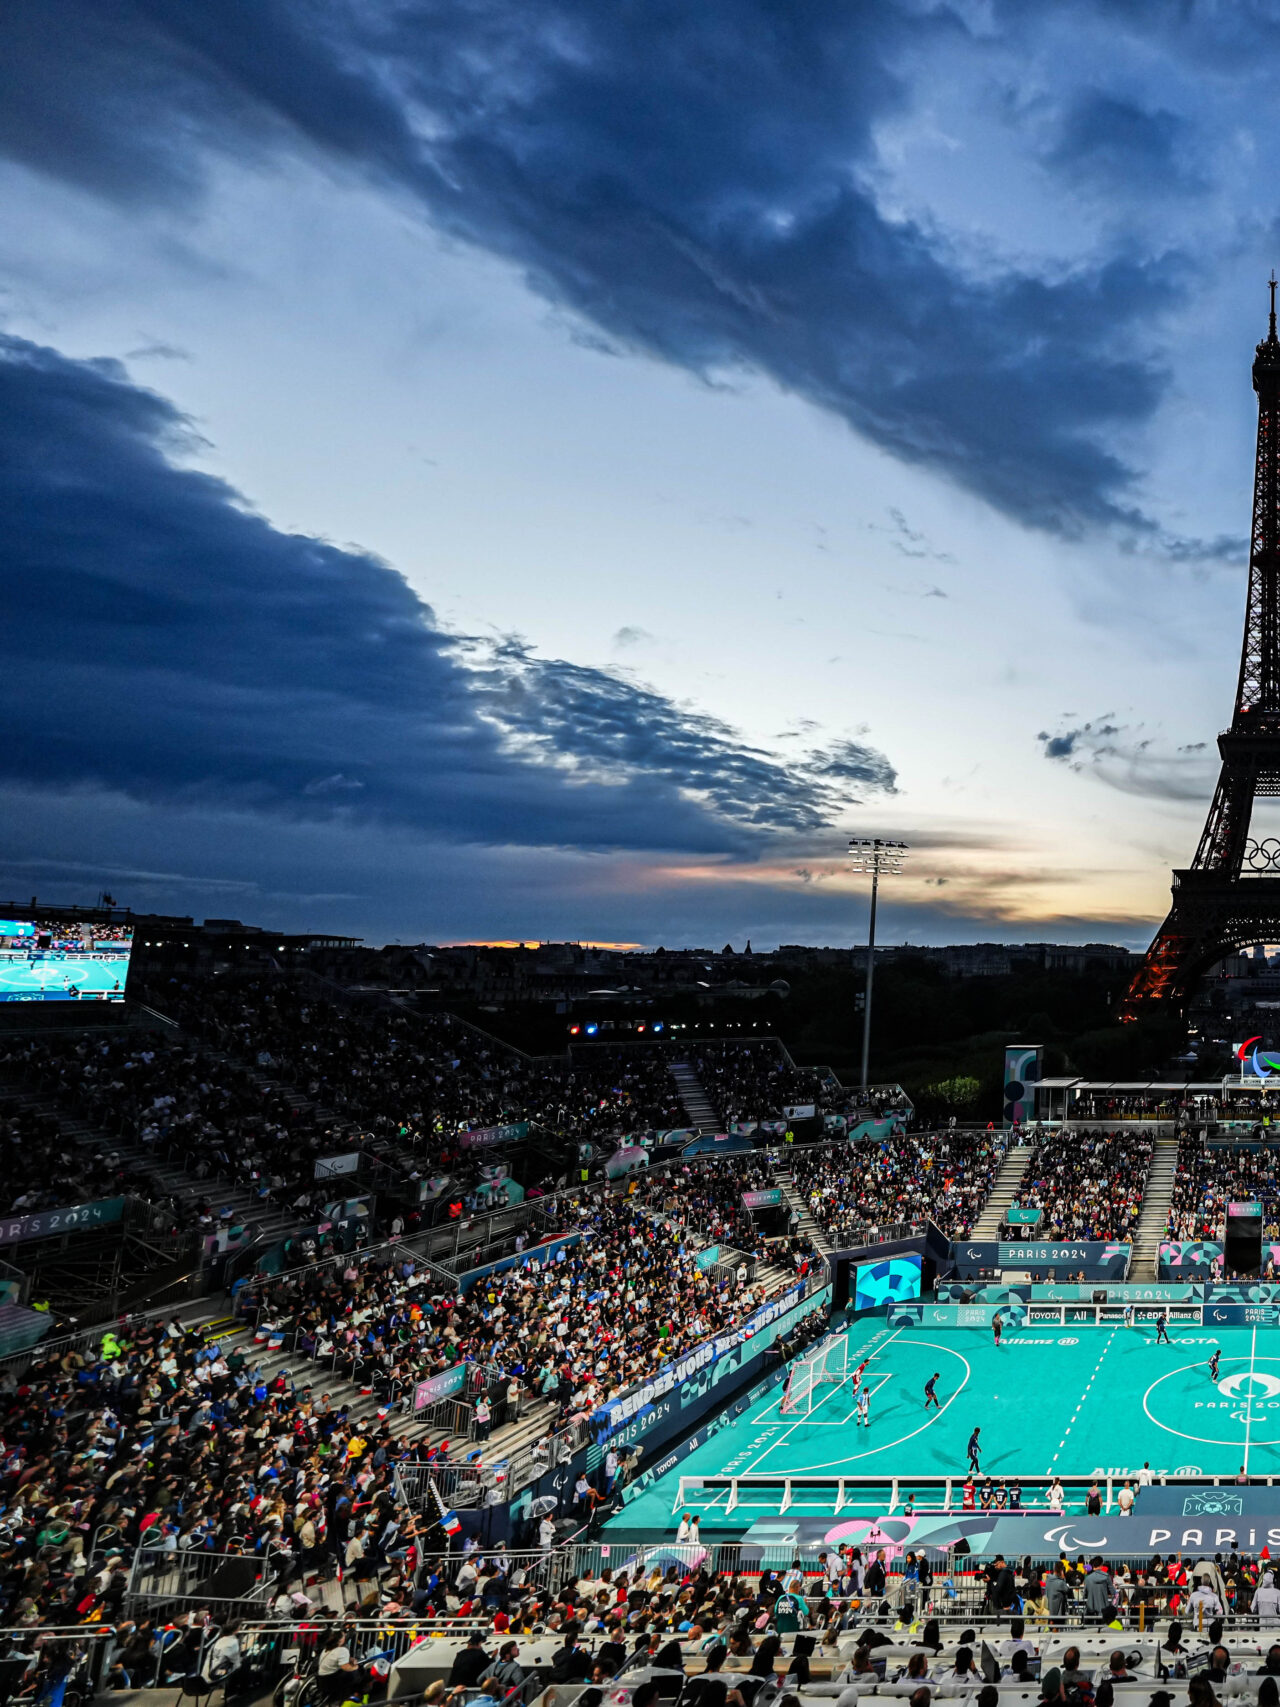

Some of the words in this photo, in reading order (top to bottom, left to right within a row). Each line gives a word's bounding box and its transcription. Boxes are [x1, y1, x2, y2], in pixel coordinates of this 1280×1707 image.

[470, 1133, 496, 1142] PARIS
[498, 1127, 519, 1138] 2024
[0, 1220, 40, 1237] RIS
[49, 1208, 101, 1228] 2024
[1009, 1249, 1047, 1259] PARIS
[1051, 1249, 1087, 1259] 2024
[1135, 1290, 1171, 1299] 2024
[1073, 1311, 1087, 1320] All
[1169, 1311, 1192, 1319] Allianz
[610, 1343, 714, 1427] RENDEZ-VOUS
[602, 1424, 637, 1458] PARIS
[641, 1402, 670, 1432] 2024
[746, 1426, 781, 1449] 2024
[688, 1437, 698, 1452] All
[656, 1455, 678, 1475] TOYOTA
